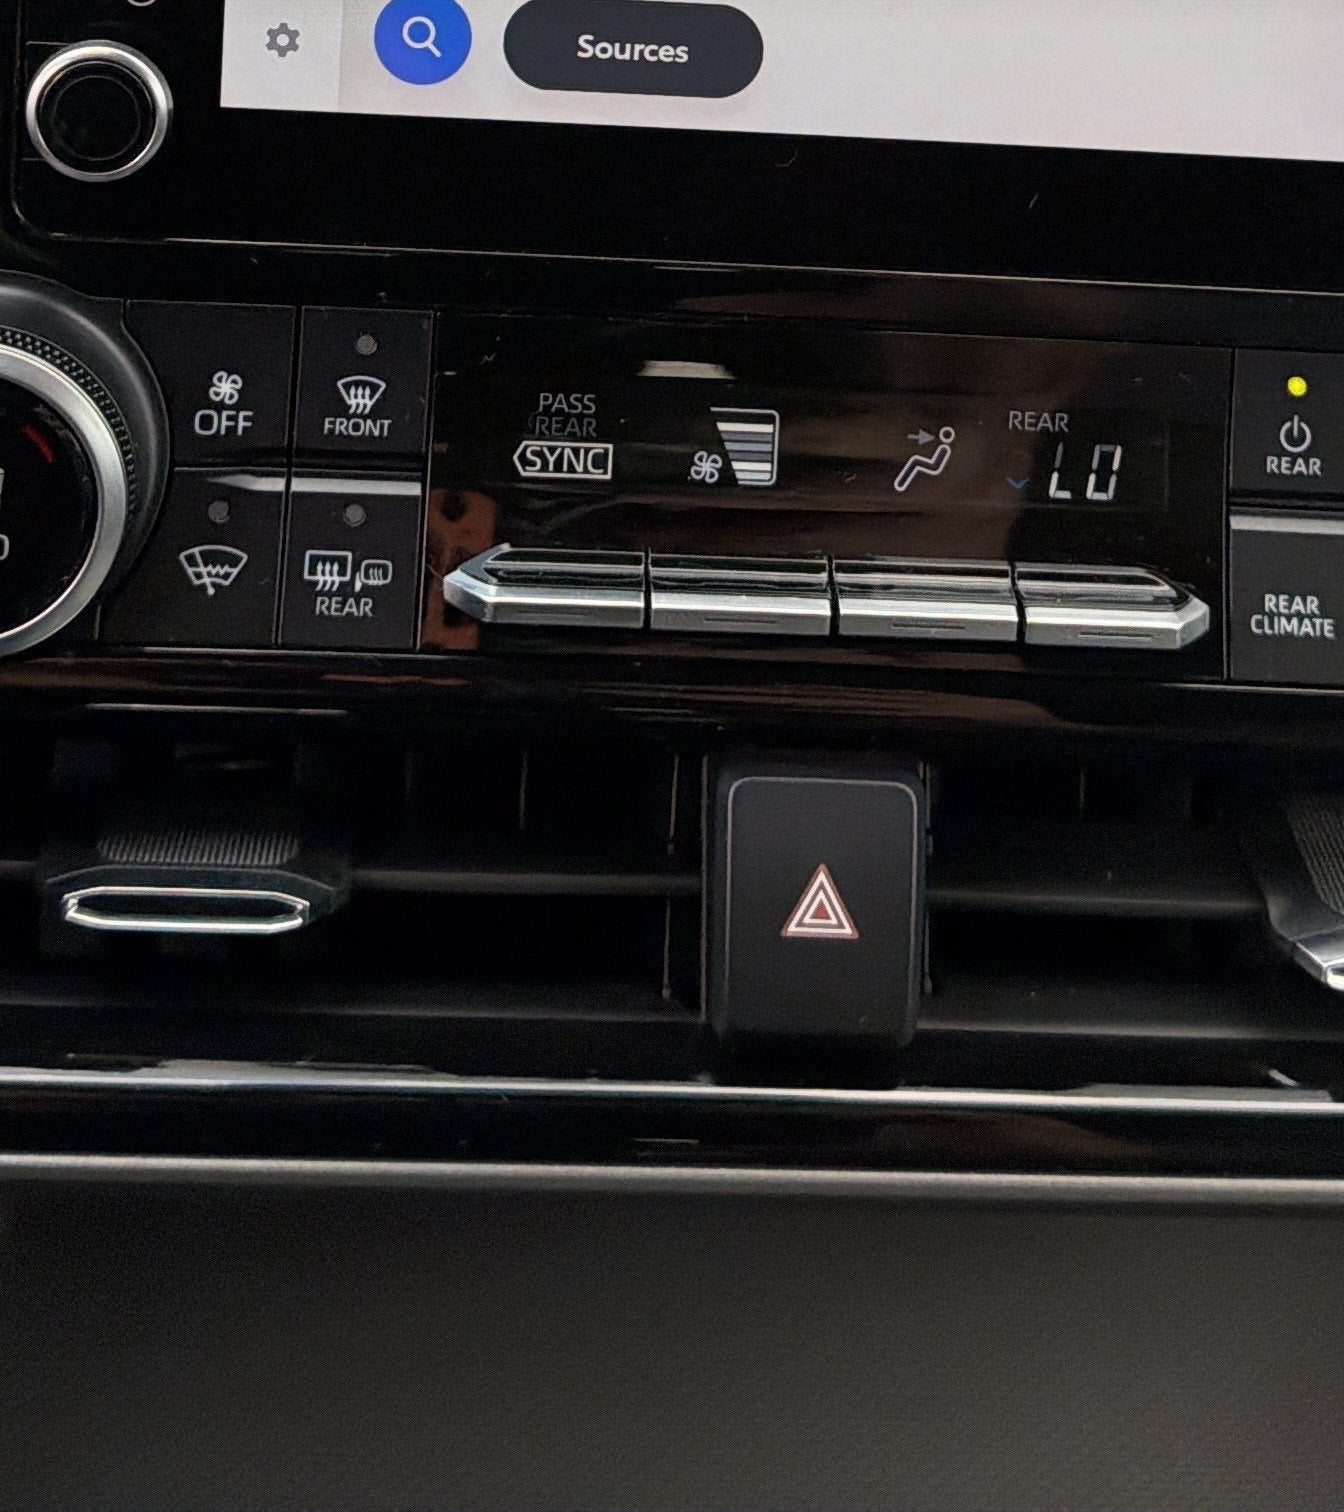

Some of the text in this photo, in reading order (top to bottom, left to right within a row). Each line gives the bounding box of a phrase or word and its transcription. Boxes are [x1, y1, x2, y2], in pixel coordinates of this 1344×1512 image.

[576, 34, 689, 64] Sources
[538, 392, 597, 414] PASS
[193, 409, 254, 437] OFF
[323, 416, 393, 438] FRONT
[535, 415, 597, 438] REAR
[1007, 409, 1069, 433] REAR
[524, 445, 605, 474] SYNC
[1266, 455, 1322, 476] REAR
[315, 595, 373, 618] REAR
[1264, 593, 1321, 616] REAR
[1250, 614, 1335, 639] CLIMATE
